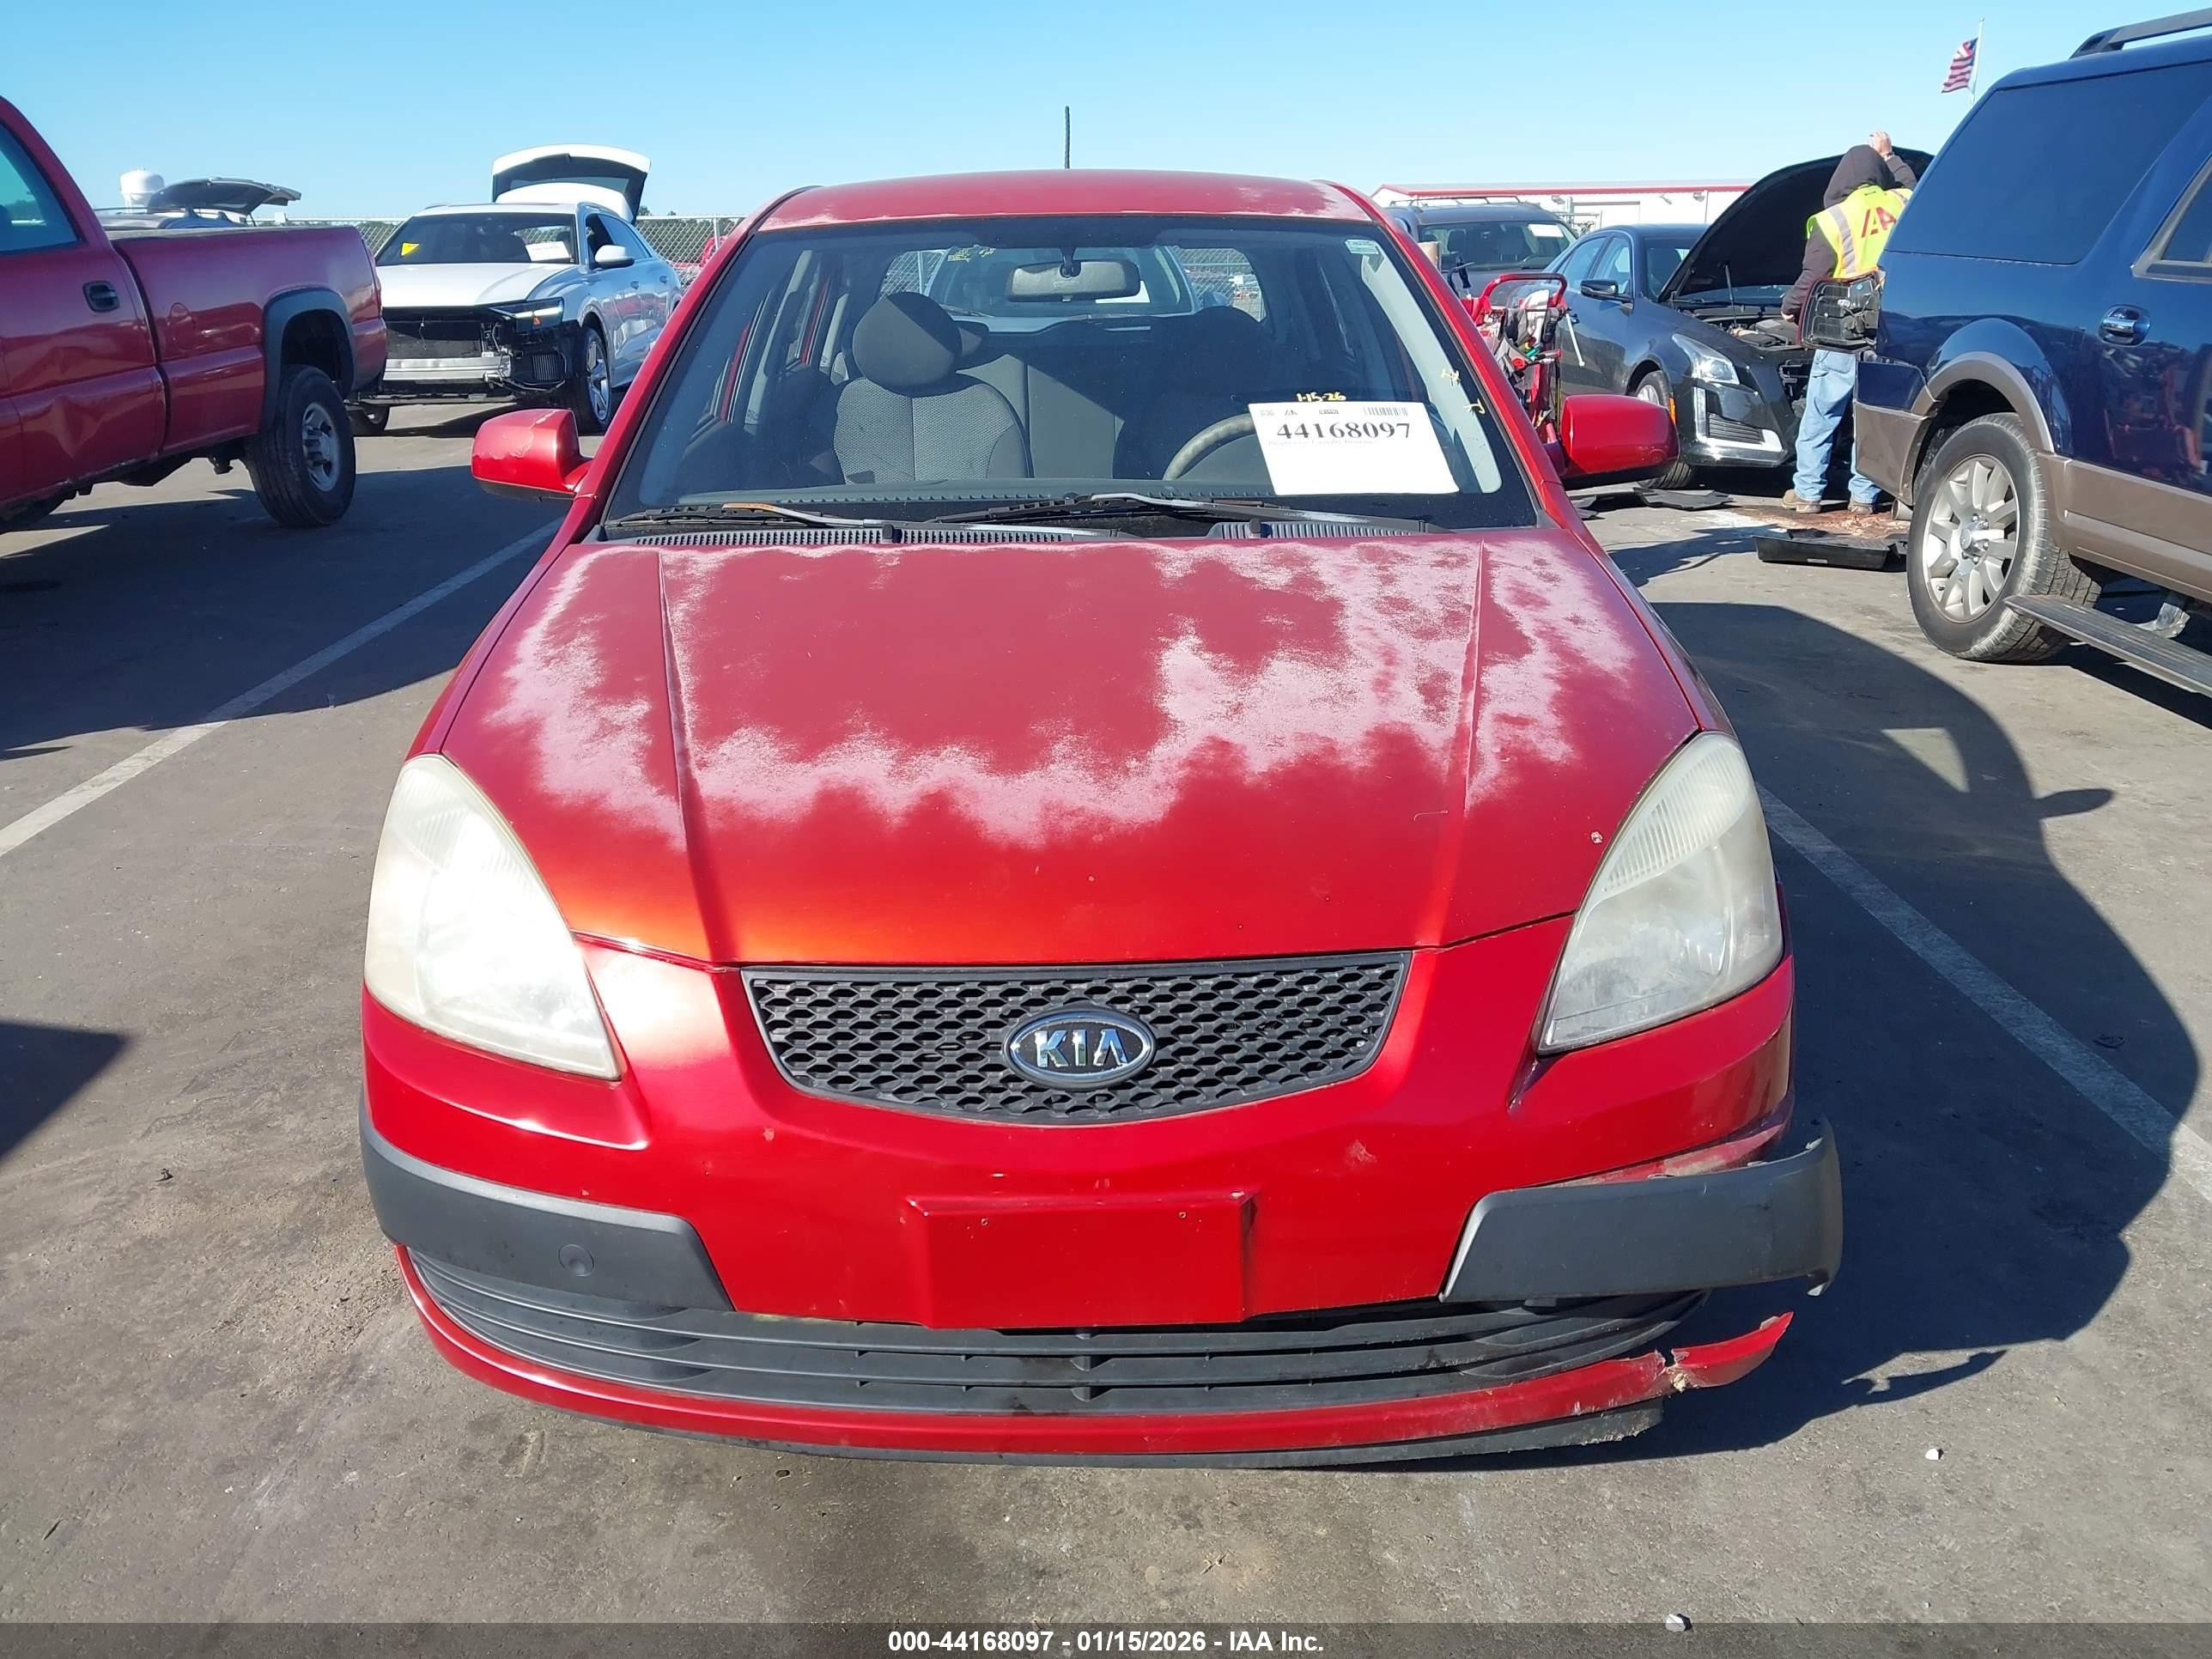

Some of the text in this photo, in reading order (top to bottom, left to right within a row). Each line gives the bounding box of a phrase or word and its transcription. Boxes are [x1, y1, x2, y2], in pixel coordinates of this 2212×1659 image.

[1296, 391, 1347, 403] 1-15-26
[1276, 422, 1410, 440] 44168097
[1034, 1029, 1127, 1067] KIA
